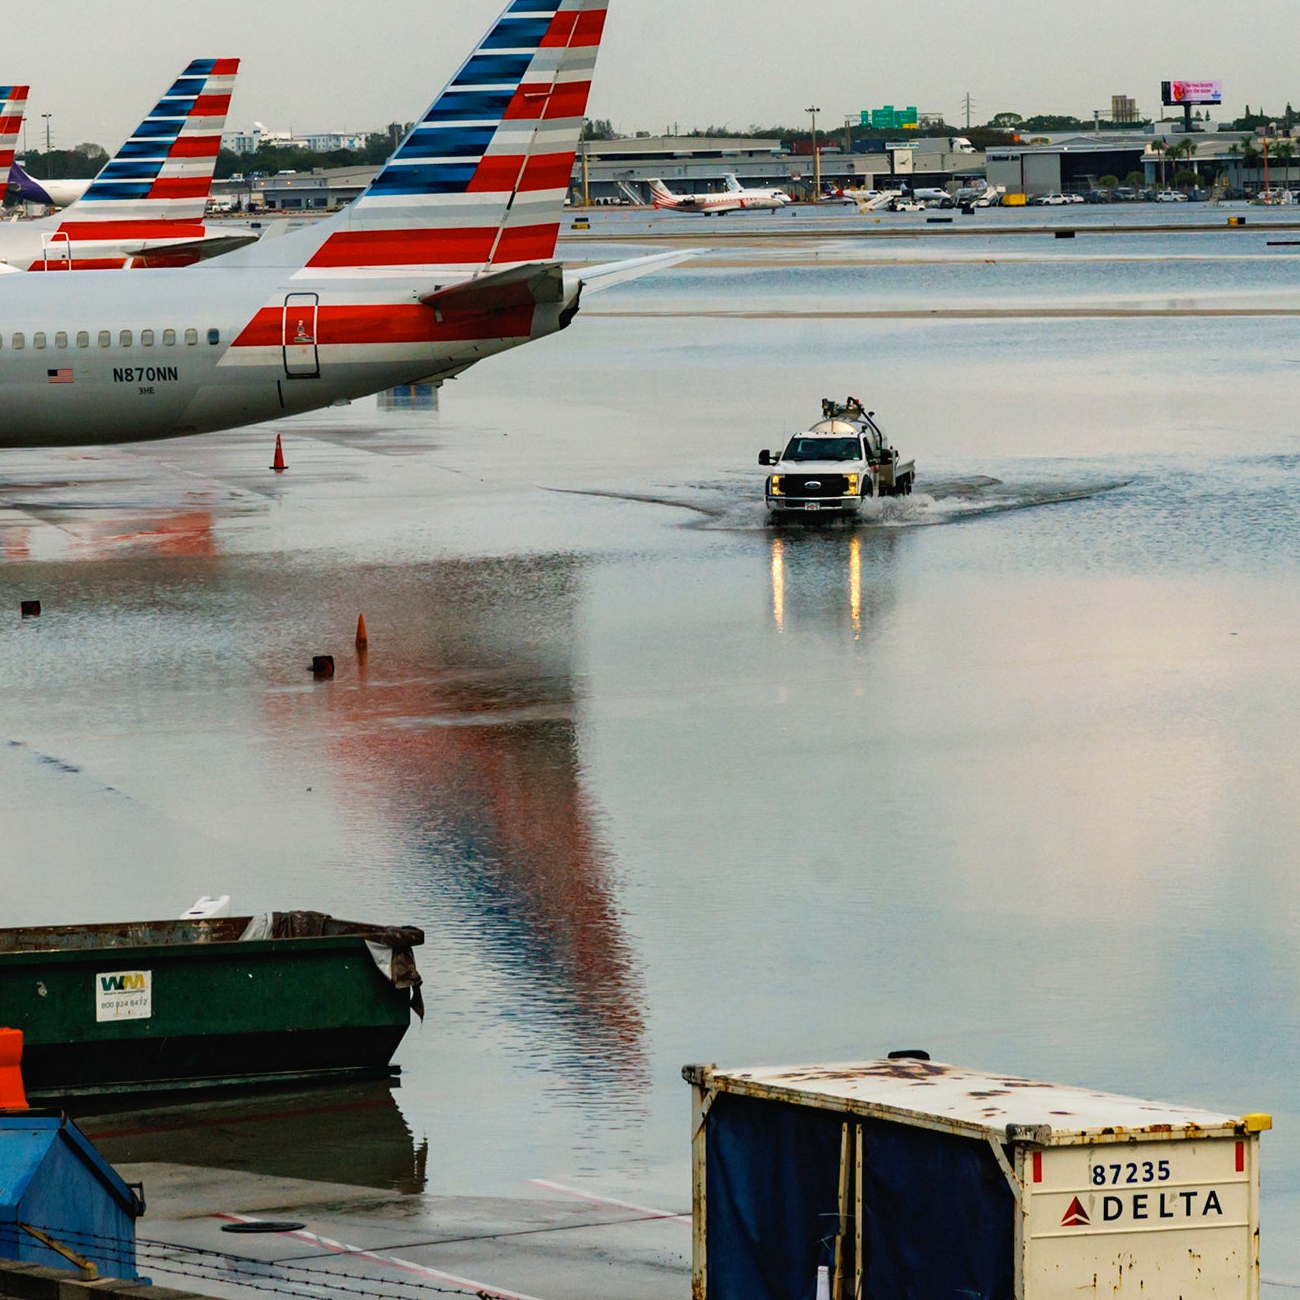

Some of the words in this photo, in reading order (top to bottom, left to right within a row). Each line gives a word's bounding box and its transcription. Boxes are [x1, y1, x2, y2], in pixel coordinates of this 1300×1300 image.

[113, 367, 179, 382] N870NN
[100, 974, 146, 991] WM
[101, 1001, 115, 1009] 800
[1092, 1160, 1171, 1186] 87235
[1102, 1190, 1223, 1221] DELTA
